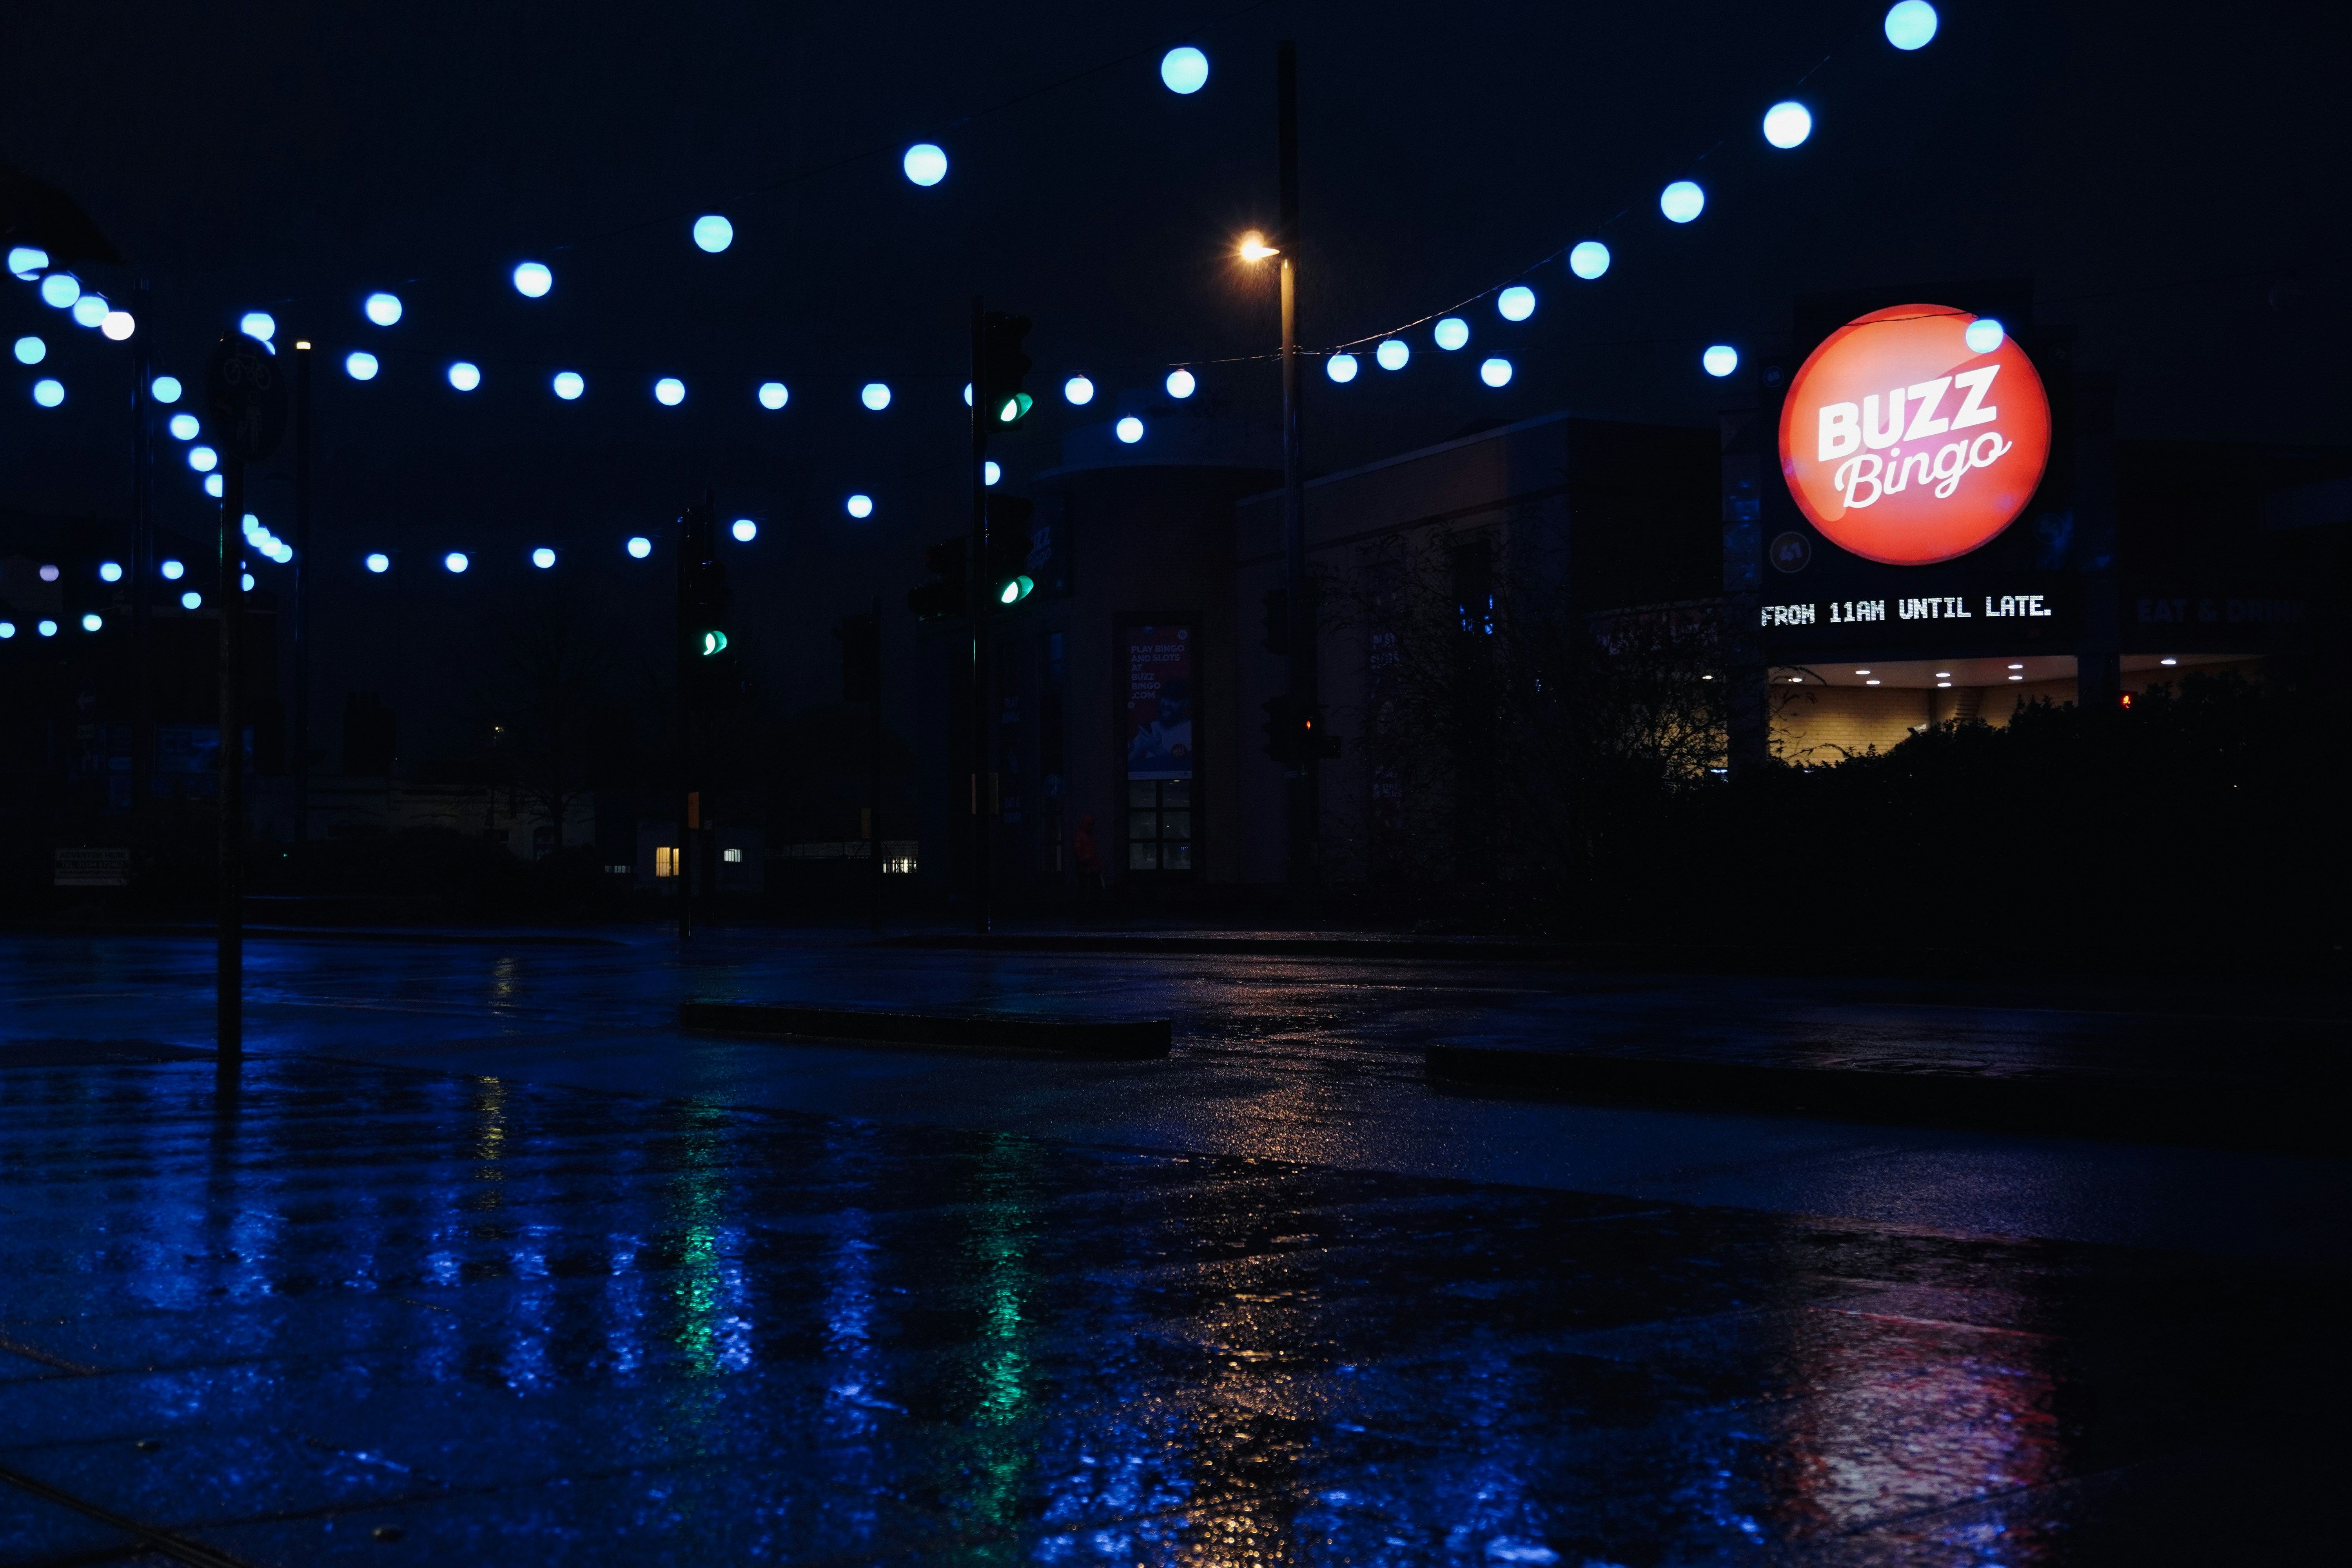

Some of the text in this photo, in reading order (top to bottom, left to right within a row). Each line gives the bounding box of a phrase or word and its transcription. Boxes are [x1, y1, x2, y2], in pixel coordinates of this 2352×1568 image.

[1818, 365, 2001, 462] BUZZ
[1835, 432, 2013, 509] Bingo
[1780, 542, 1802, 561] 61
[1761, 595, 2052, 627] FROM 11AM UNTIL LATE.
[2137, 598, 2307, 622] EAT & DRINK
